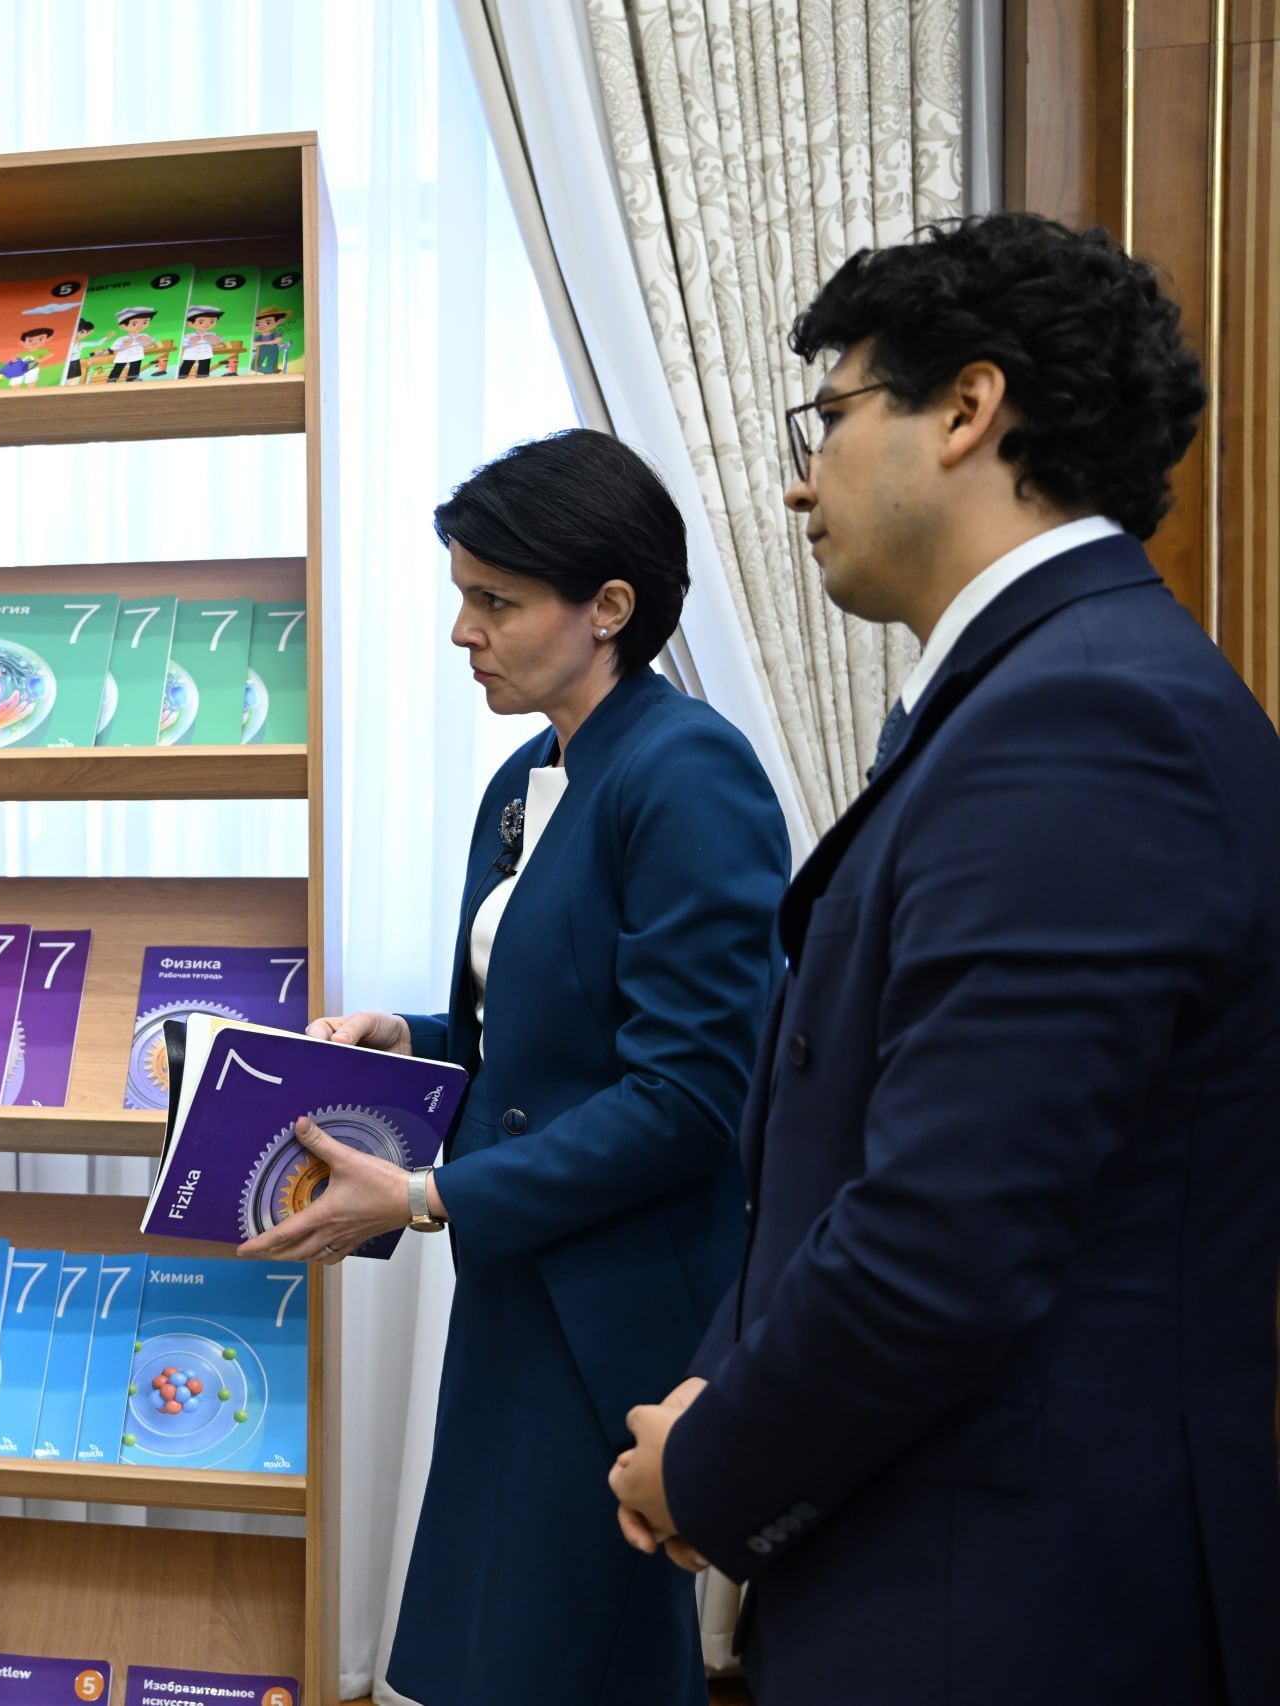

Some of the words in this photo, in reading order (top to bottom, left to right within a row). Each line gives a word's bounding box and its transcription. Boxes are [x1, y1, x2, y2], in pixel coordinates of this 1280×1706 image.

[59, 284, 73, 296] 5
[159, 276, 172, 287] 5
[223, 277, 237, 288] 5
[280, 276, 293, 286] 5
[64, 604, 101, 645] 7
[124, 606, 161, 649] 7
[201, 610, 239, 652] 7
[268, 610, 306, 653] 7
[39, 942, 76, 989] 7
[160, 958, 222, 970] Физика
[270, 958, 305, 1003] 7
[215, 1048, 283, 1091] 7
[423, 1085, 444, 1112] novda
[168, 1169, 202, 1220] Fizika
[11, 1262, 48, 1314] 7
[56, 1266, 88, 1319] 7
[100, 1266, 132, 1320] 7
[149, 1270, 204, 1285] Химия
[266, 1274, 304, 1328] 7
[82, 1676, 96, 1696] 5
[143, 1679, 255, 1699] Изобразительное
[270, 1694, 284, 1706] 5
